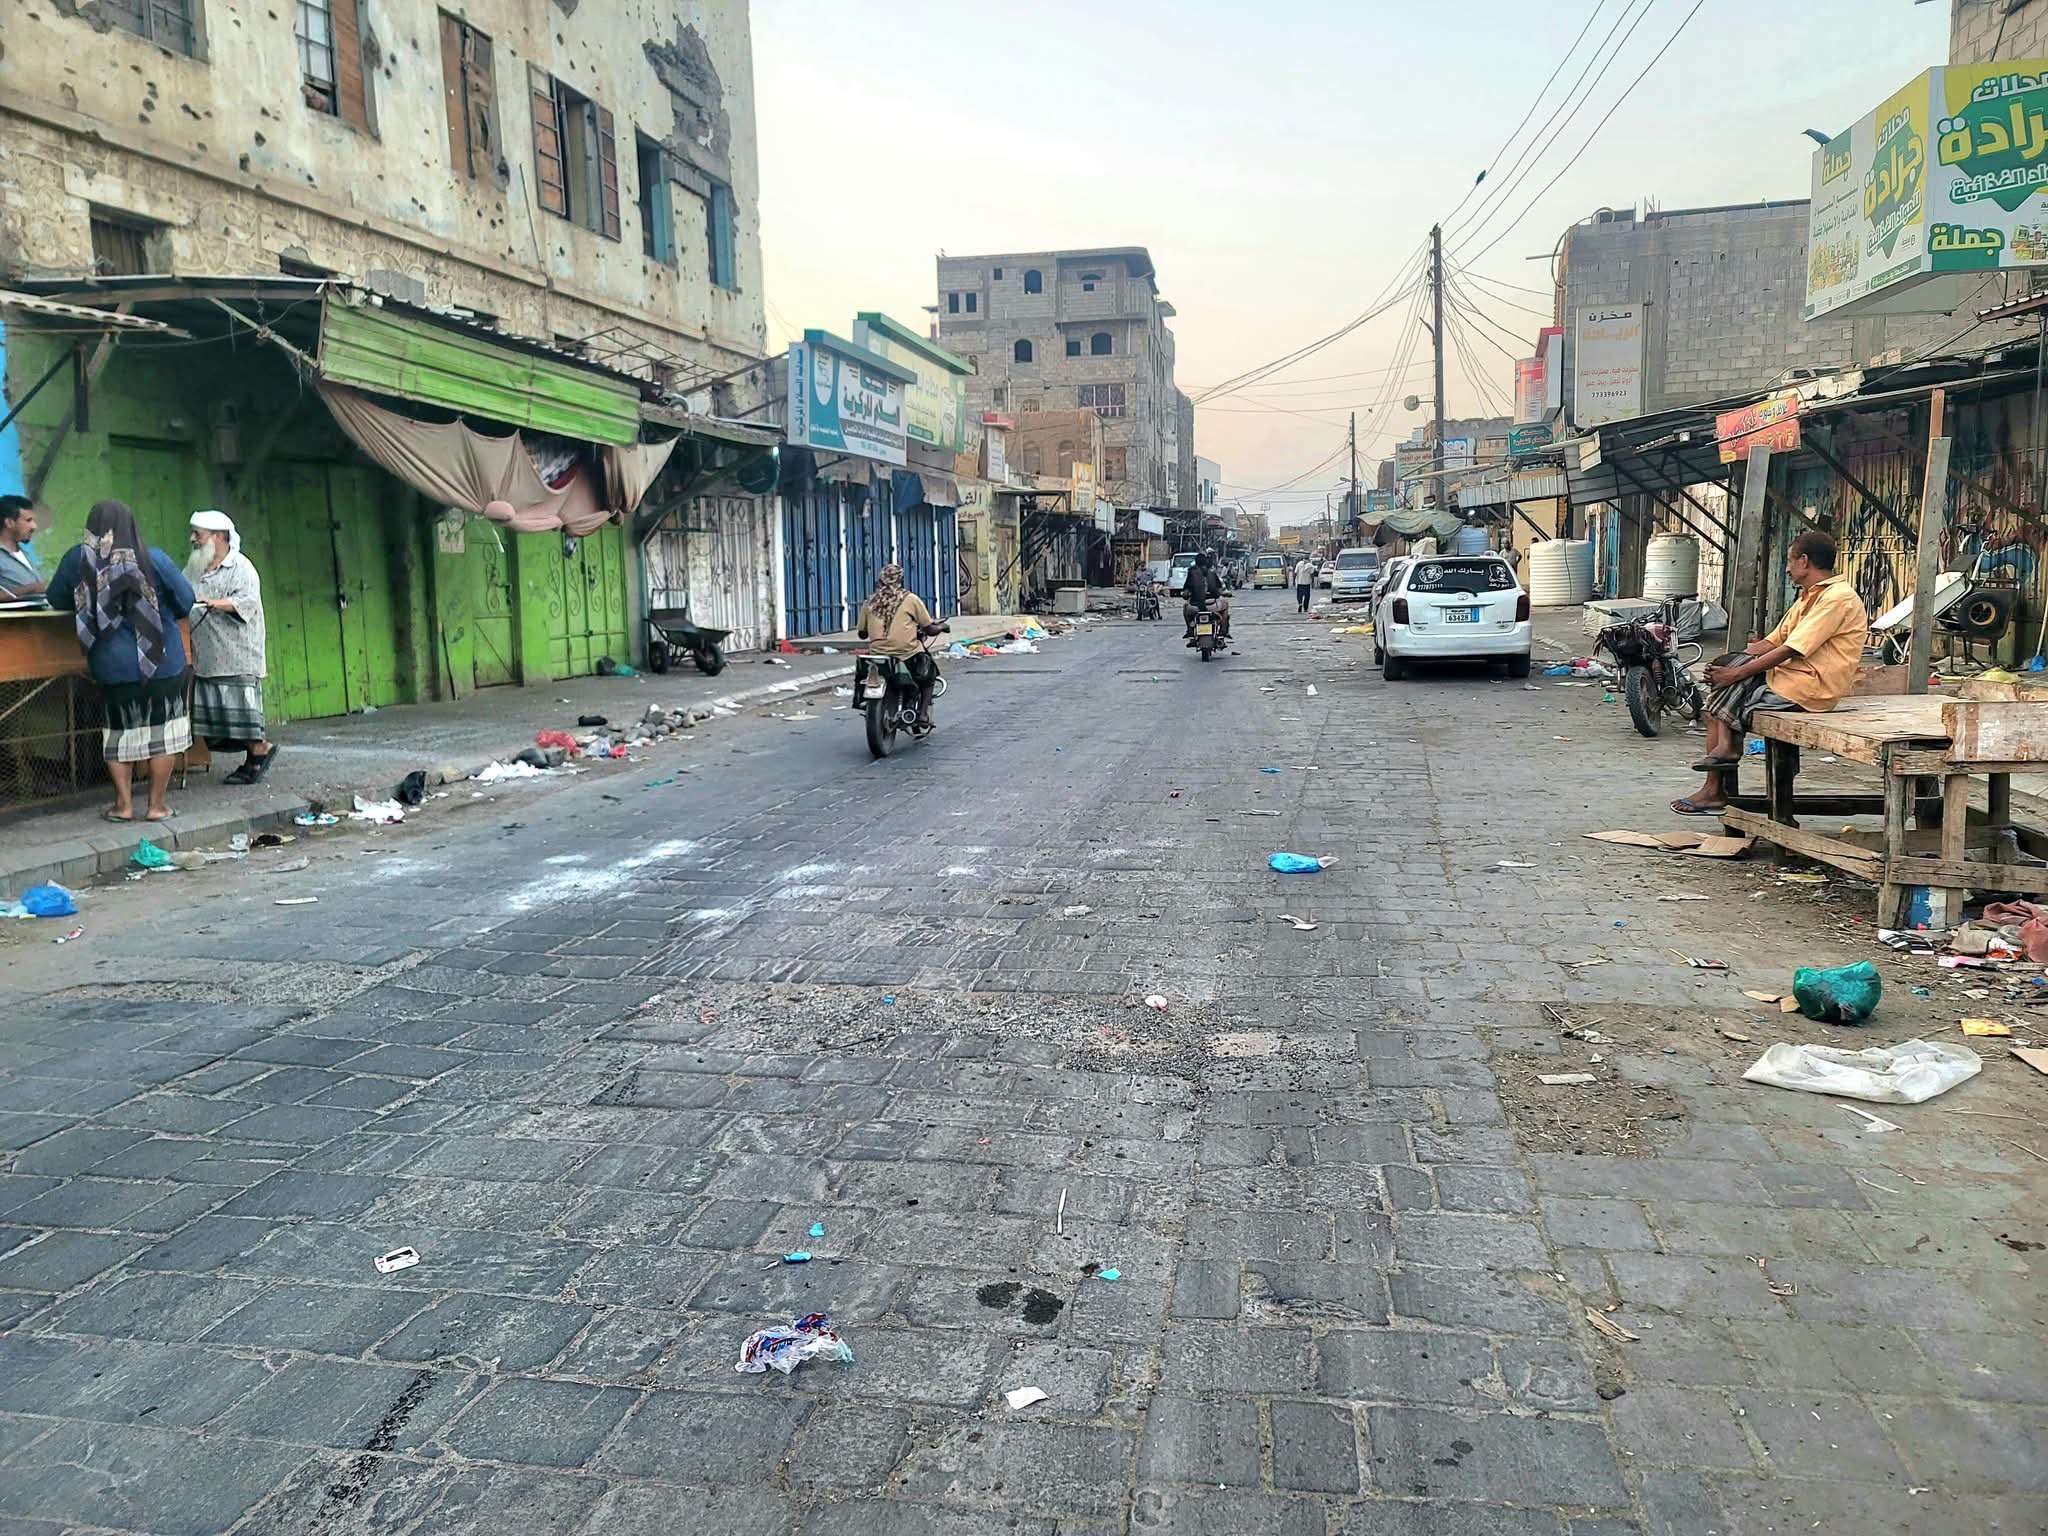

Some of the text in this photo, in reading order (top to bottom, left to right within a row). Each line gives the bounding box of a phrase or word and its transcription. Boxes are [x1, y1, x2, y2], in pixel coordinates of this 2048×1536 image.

[1878, 106, 1911, 151] محلات
[1938, 103, 2048, 164] رادة
[1823, 151, 1851, 186] جملة
[1865, 137, 1923, 218] جرادة
[1932, 226, 2001, 255] جملة
[1588, 311, 1632, 323] مخزن
